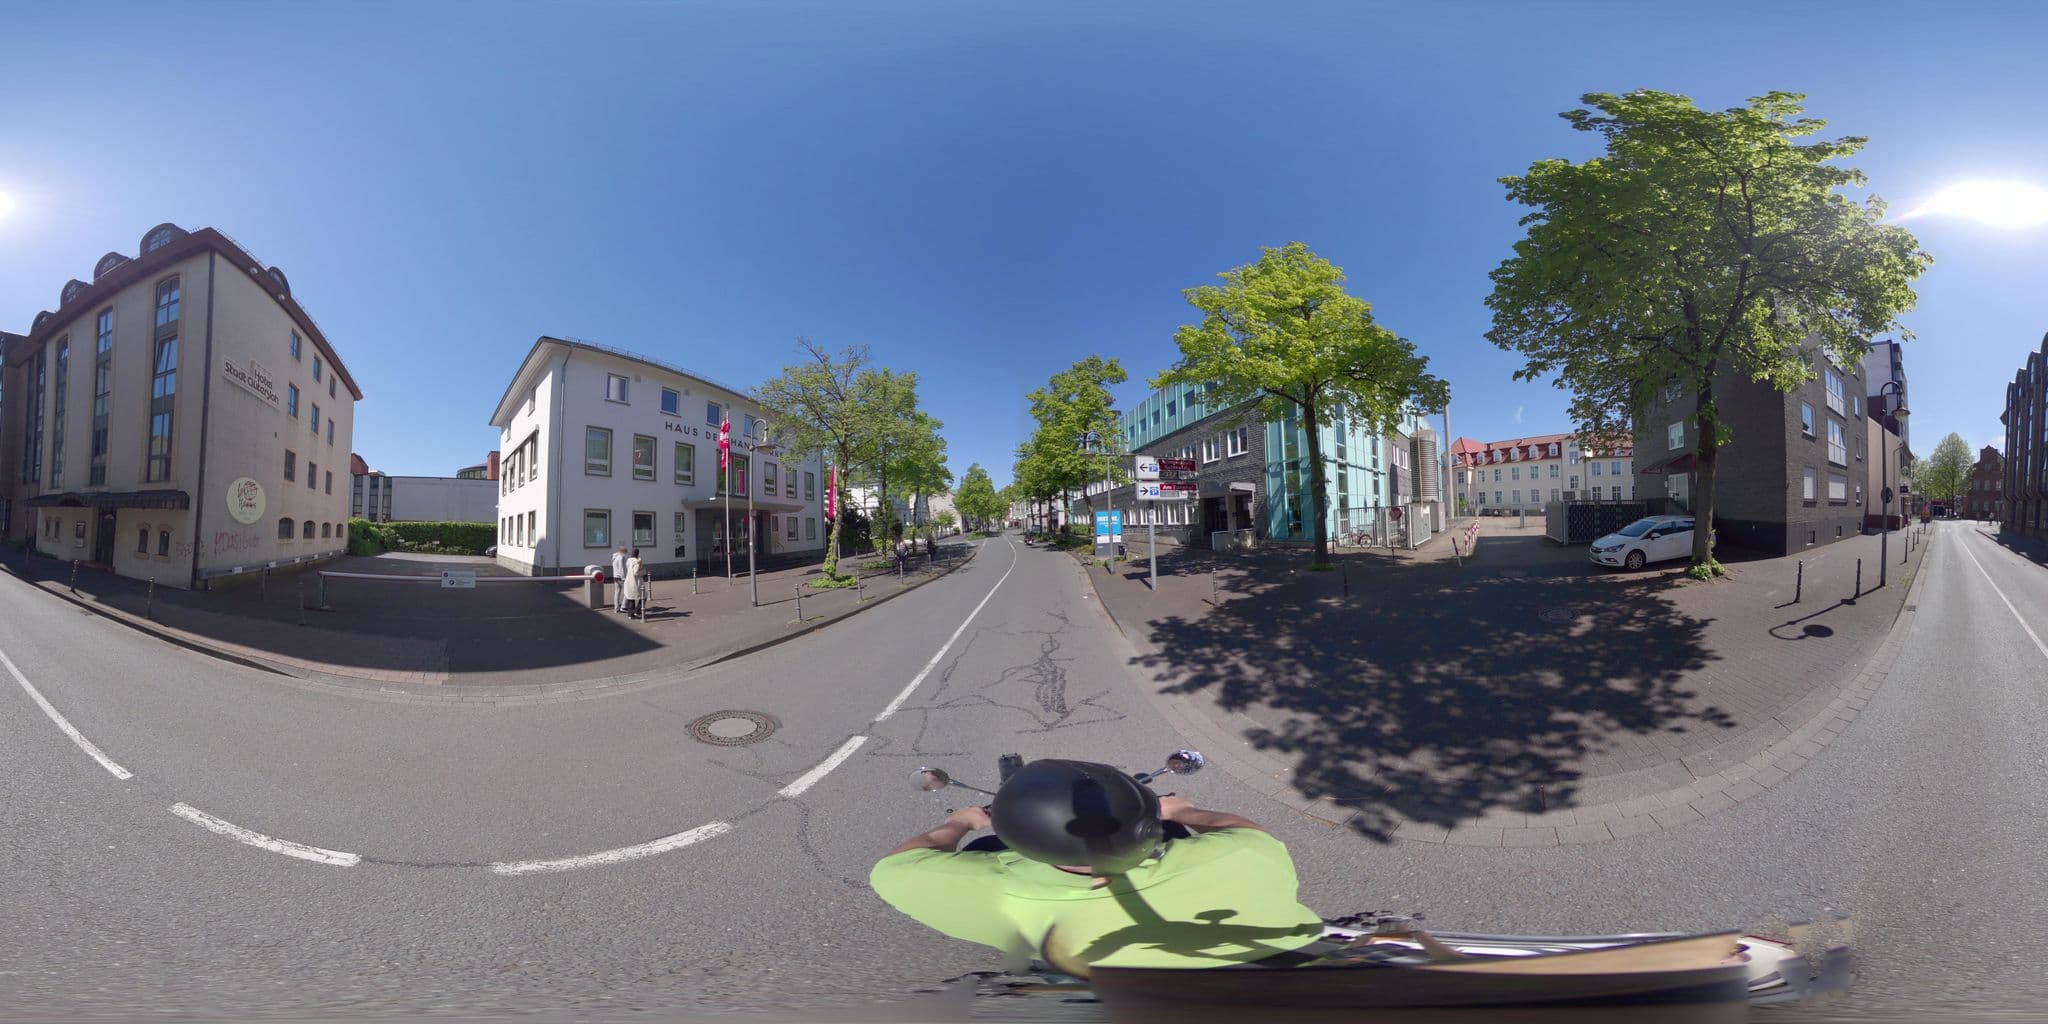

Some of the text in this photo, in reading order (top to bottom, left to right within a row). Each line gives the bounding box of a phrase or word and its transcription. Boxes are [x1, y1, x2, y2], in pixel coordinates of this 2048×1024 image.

[225, 361, 247, 383] Stadt
[254, 369, 273, 389] Hotel
[665, 421, 698, 436] HAUS
